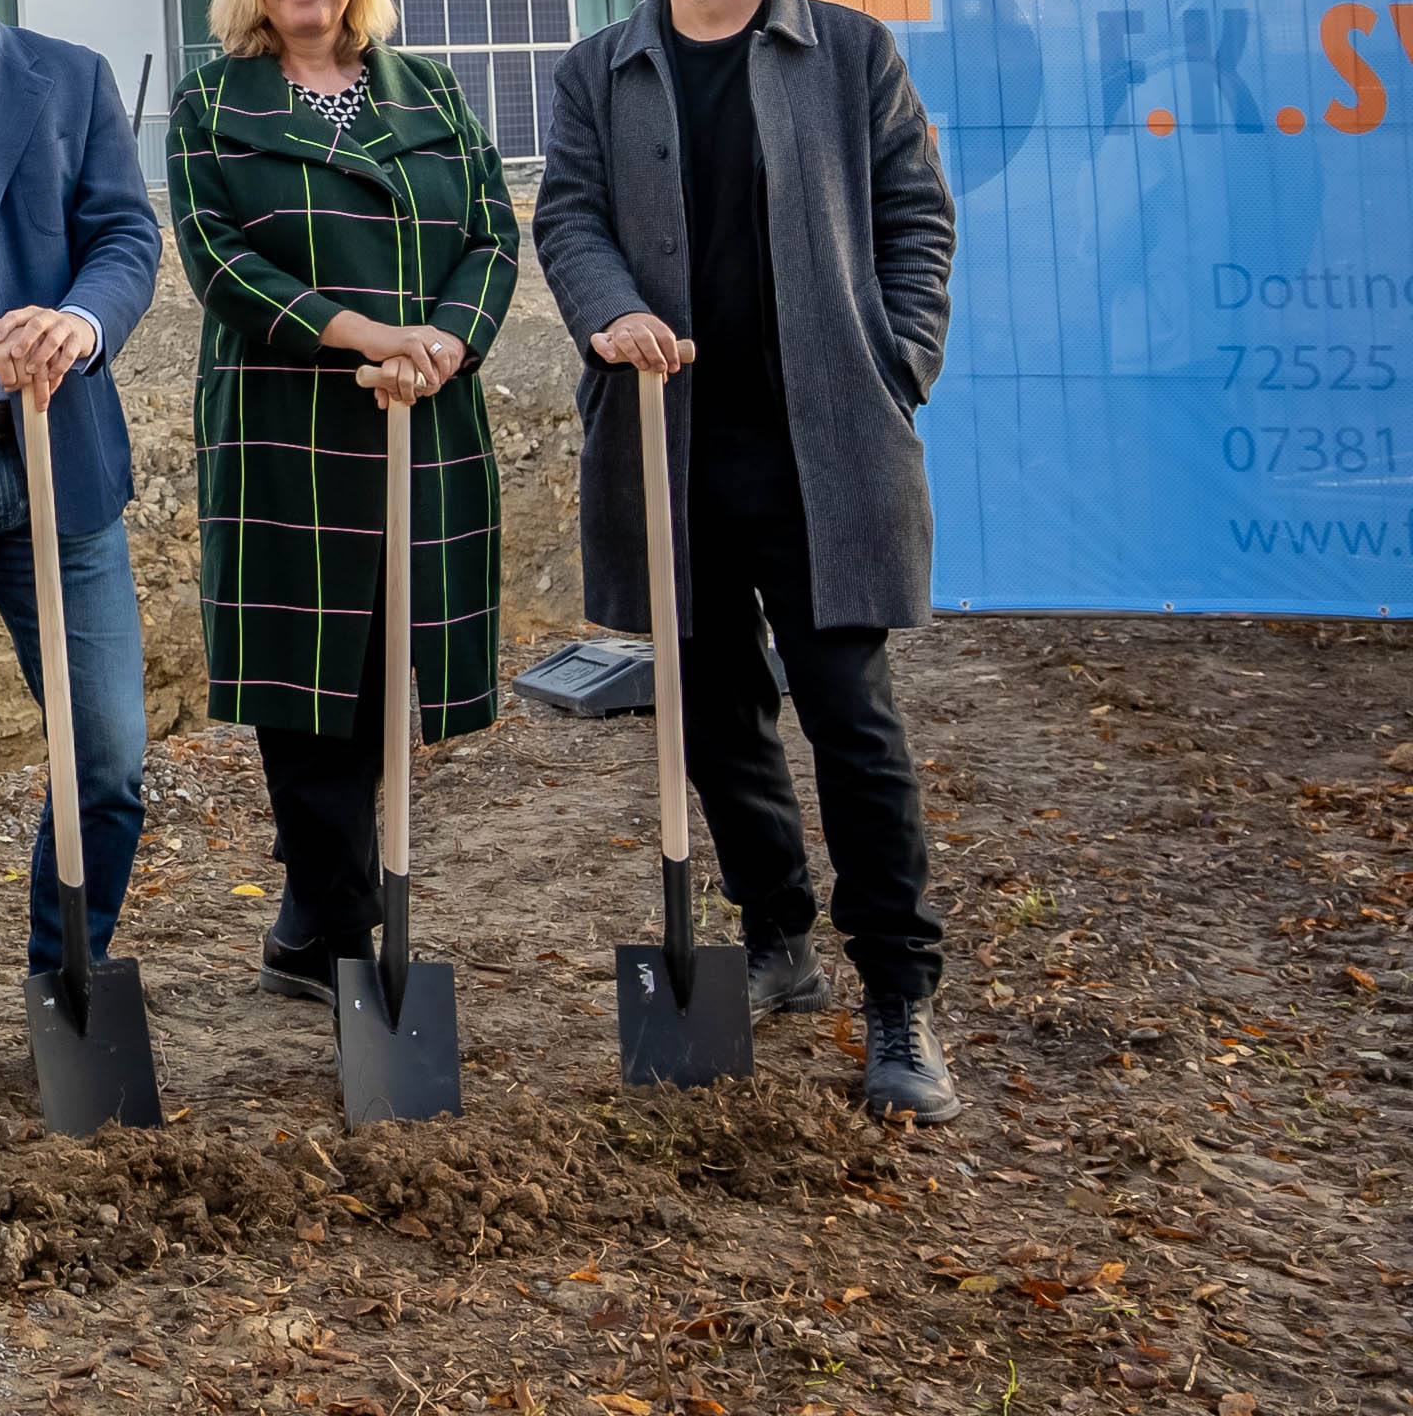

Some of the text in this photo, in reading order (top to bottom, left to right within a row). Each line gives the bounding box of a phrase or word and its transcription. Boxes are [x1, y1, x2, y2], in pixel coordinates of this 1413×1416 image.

[1096, 2, 1413, 137] F.K.S
[1217, 344, 1398, 392] 72525
[1224, 426, 1397, 474] 07381
